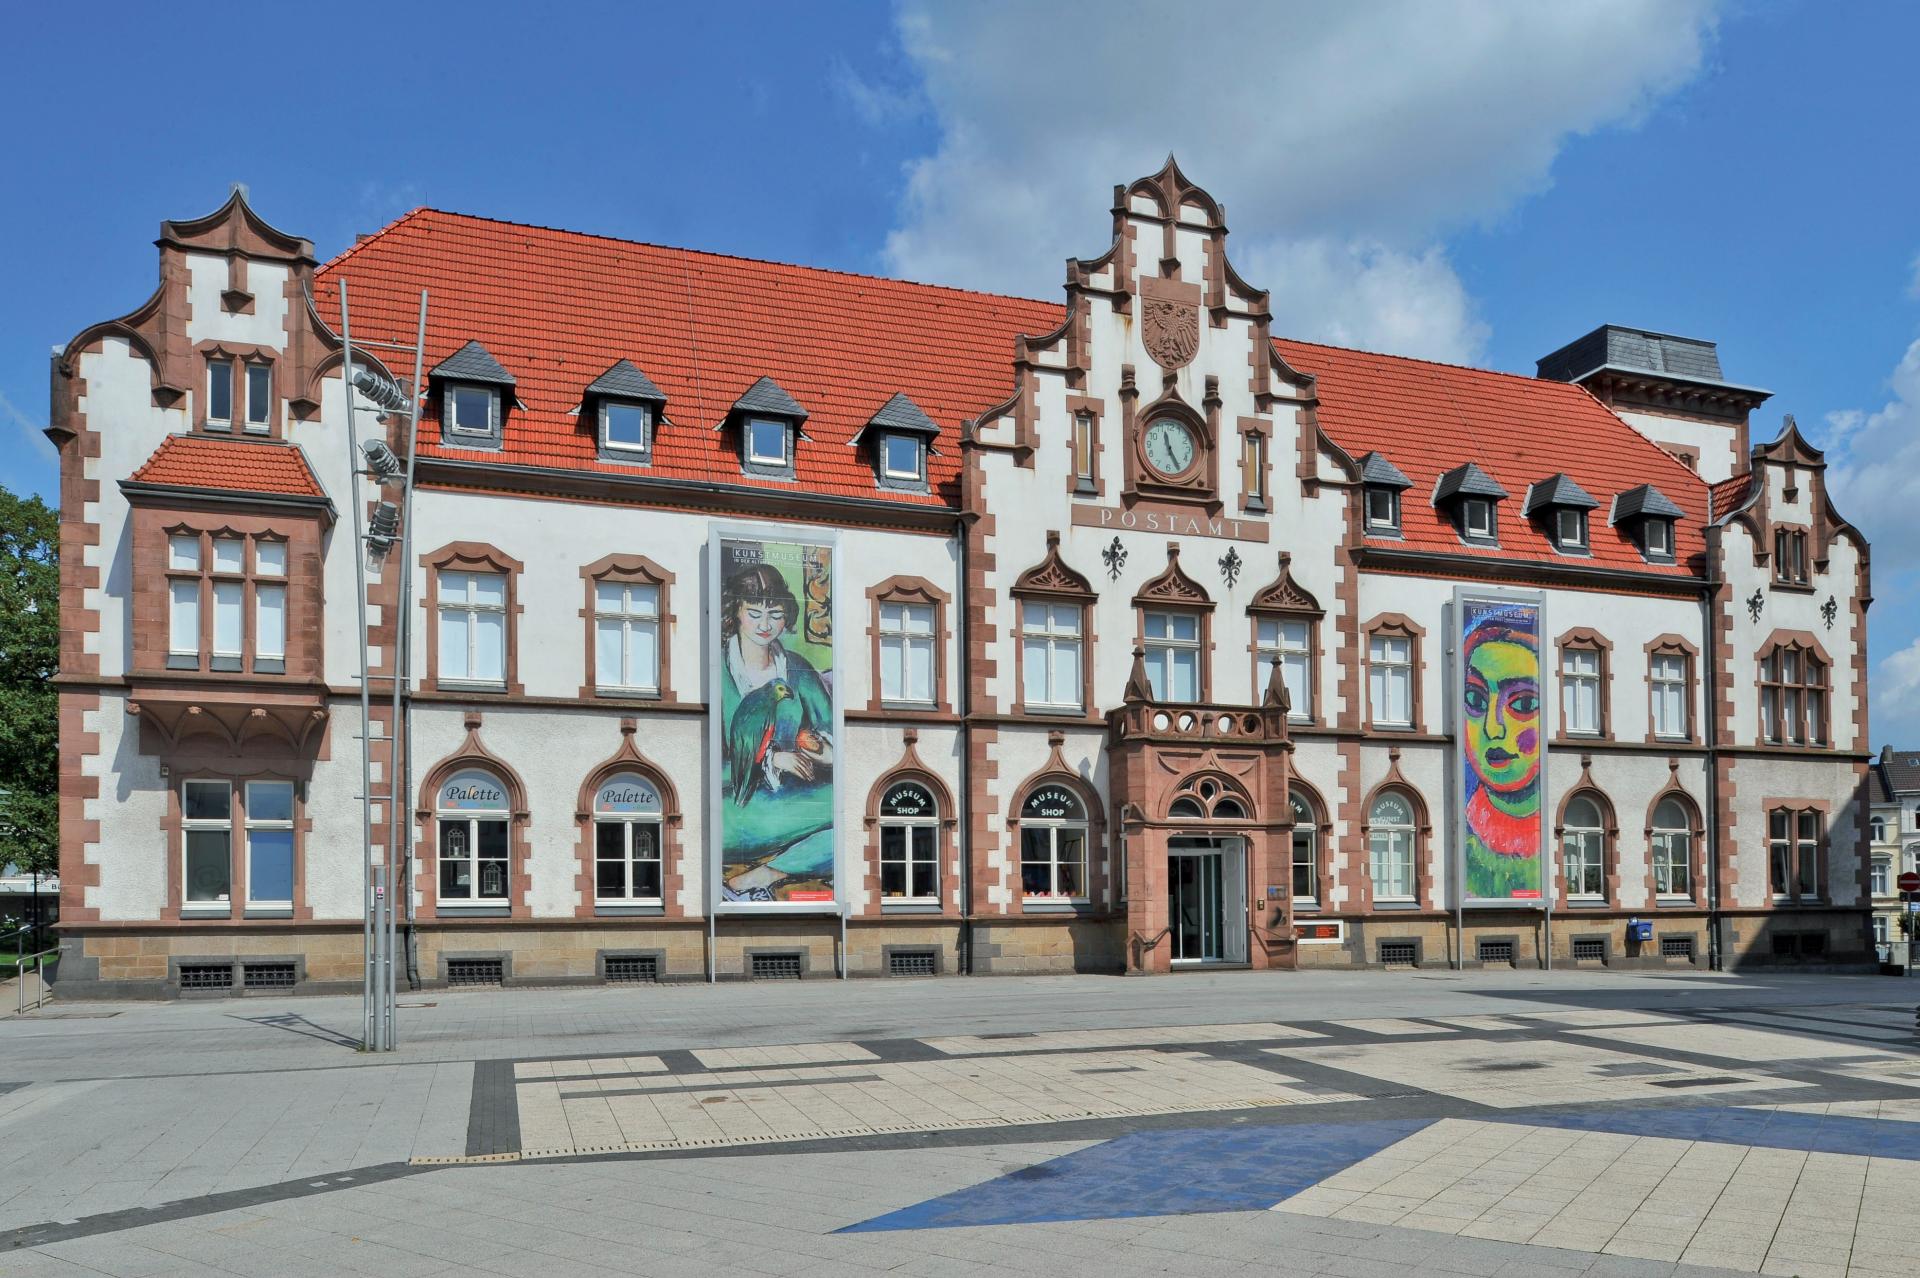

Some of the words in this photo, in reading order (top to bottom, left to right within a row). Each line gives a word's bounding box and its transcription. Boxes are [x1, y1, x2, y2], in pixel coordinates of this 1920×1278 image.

[1156, 424, 1164, 433] 11
[1149, 432, 1158, 440] 10
[1100, 508, 1242, 538] POSTAMT
[735, 548, 817, 563] KUNSTMUSEUM
[446, 785, 500, 800] Palette
[603, 789, 653, 803] Palette
[890, 790, 926, 807] MUSEUM
[1031, 792, 1074, 808] MUSEUM
[1041, 808, 1064, 816] SHOP
[1376, 801, 1403, 815] MUSEUM
